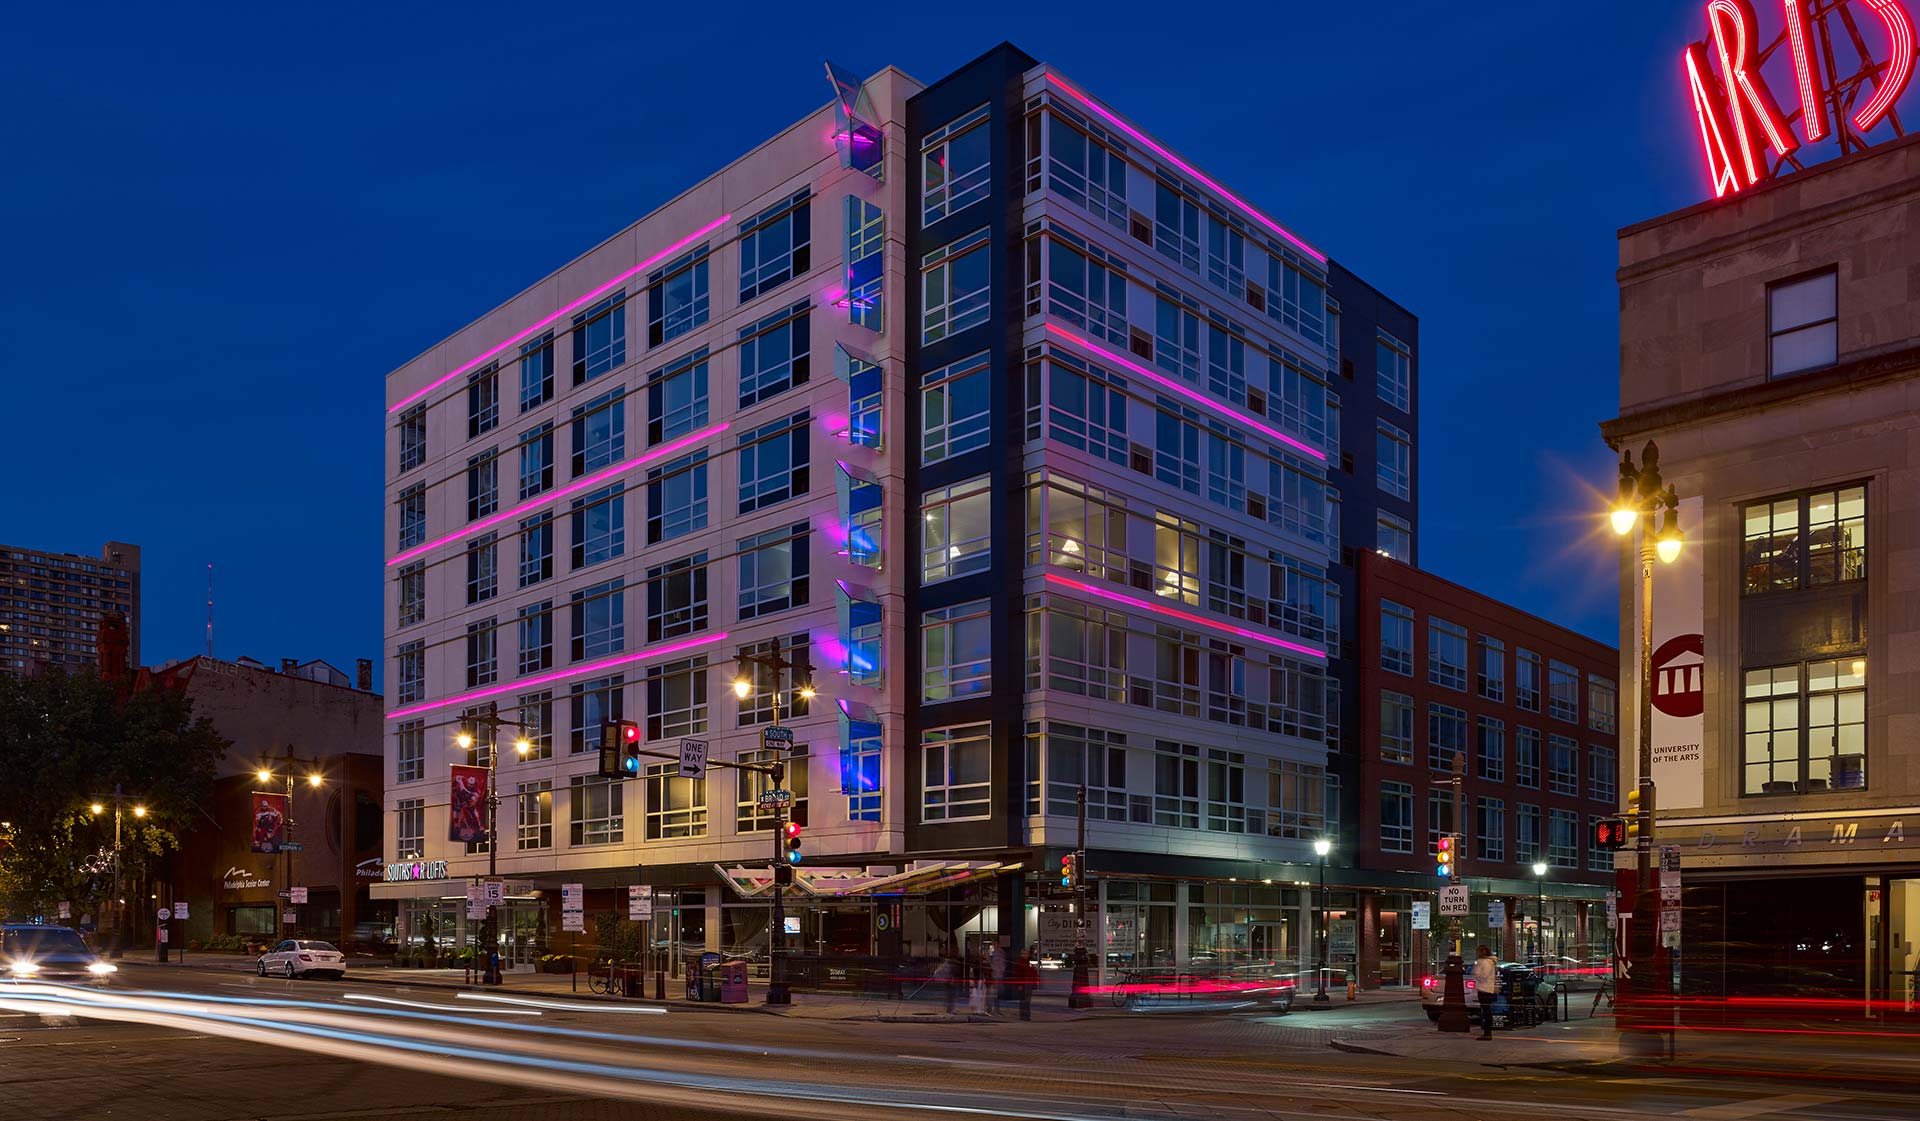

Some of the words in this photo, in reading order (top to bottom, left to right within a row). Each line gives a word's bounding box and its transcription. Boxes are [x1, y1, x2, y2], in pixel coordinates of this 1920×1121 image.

[686, 742, 702, 753] ONE
[1654, 744, 1700, 754] UNIVERSITY
[684, 752, 702, 763] WAY
[1680, 753, 1700, 761] ARTS
[1697, 821, 1904, 849] DRAMA
[427, 861, 447, 880] LOFTS
[245, 880, 257, 888] Senior
[257, 879, 271, 888] Center
[488, 890, 499, 898] 15
[1448, 887, 1459, 895] NO
[1453, 904, 1469, 912] RED
[1062, 919, 1091, 928] DINR
